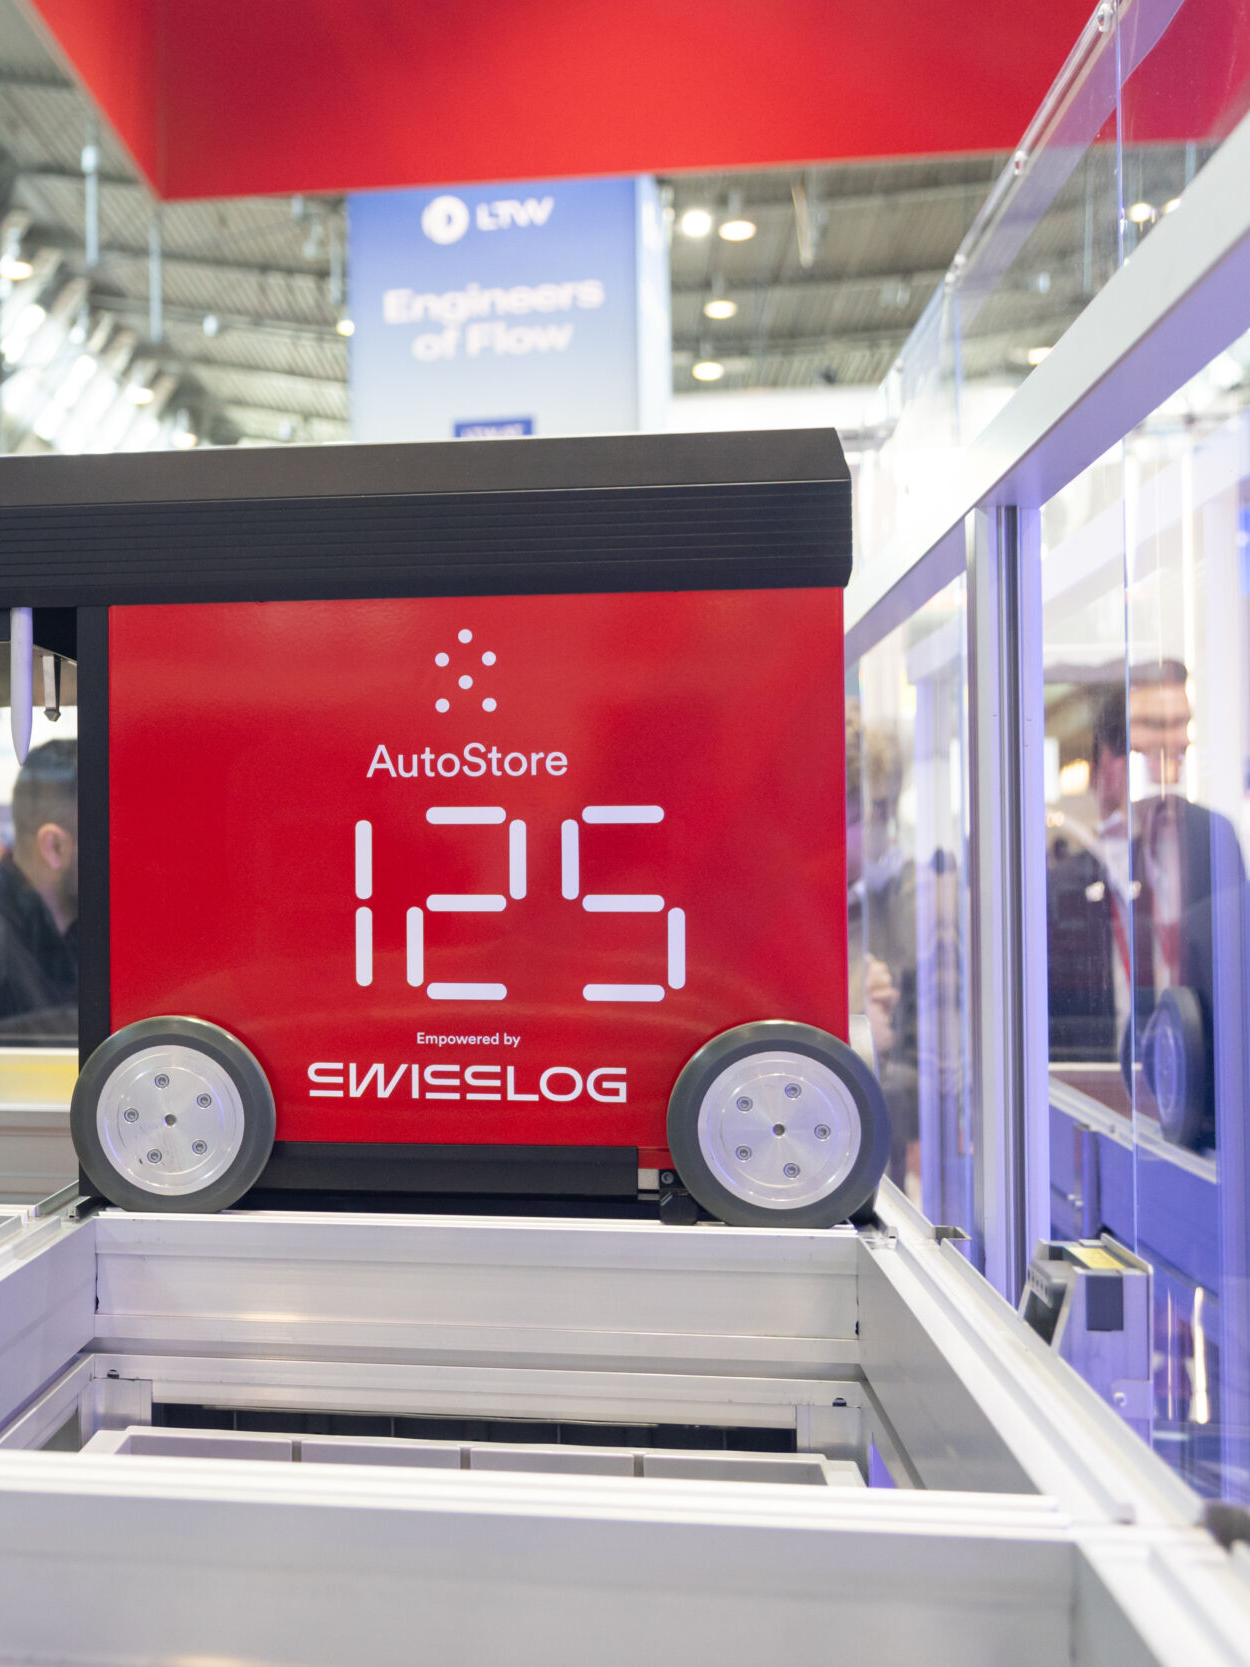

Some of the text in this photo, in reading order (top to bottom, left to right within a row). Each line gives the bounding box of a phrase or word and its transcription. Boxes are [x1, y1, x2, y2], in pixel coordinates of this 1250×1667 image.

[476, 196, 555, 231] LTW
[383, 279, 605, 327] Engineers
[412, 320, 574, 361] of Flow
[367, 742, 568, 778] AutoStore
[354, 804, 687, 1003] 125
[416, 1031, 521, 1048] Empowered by
[307, 1061, 628, 1103] SWISSLOG
